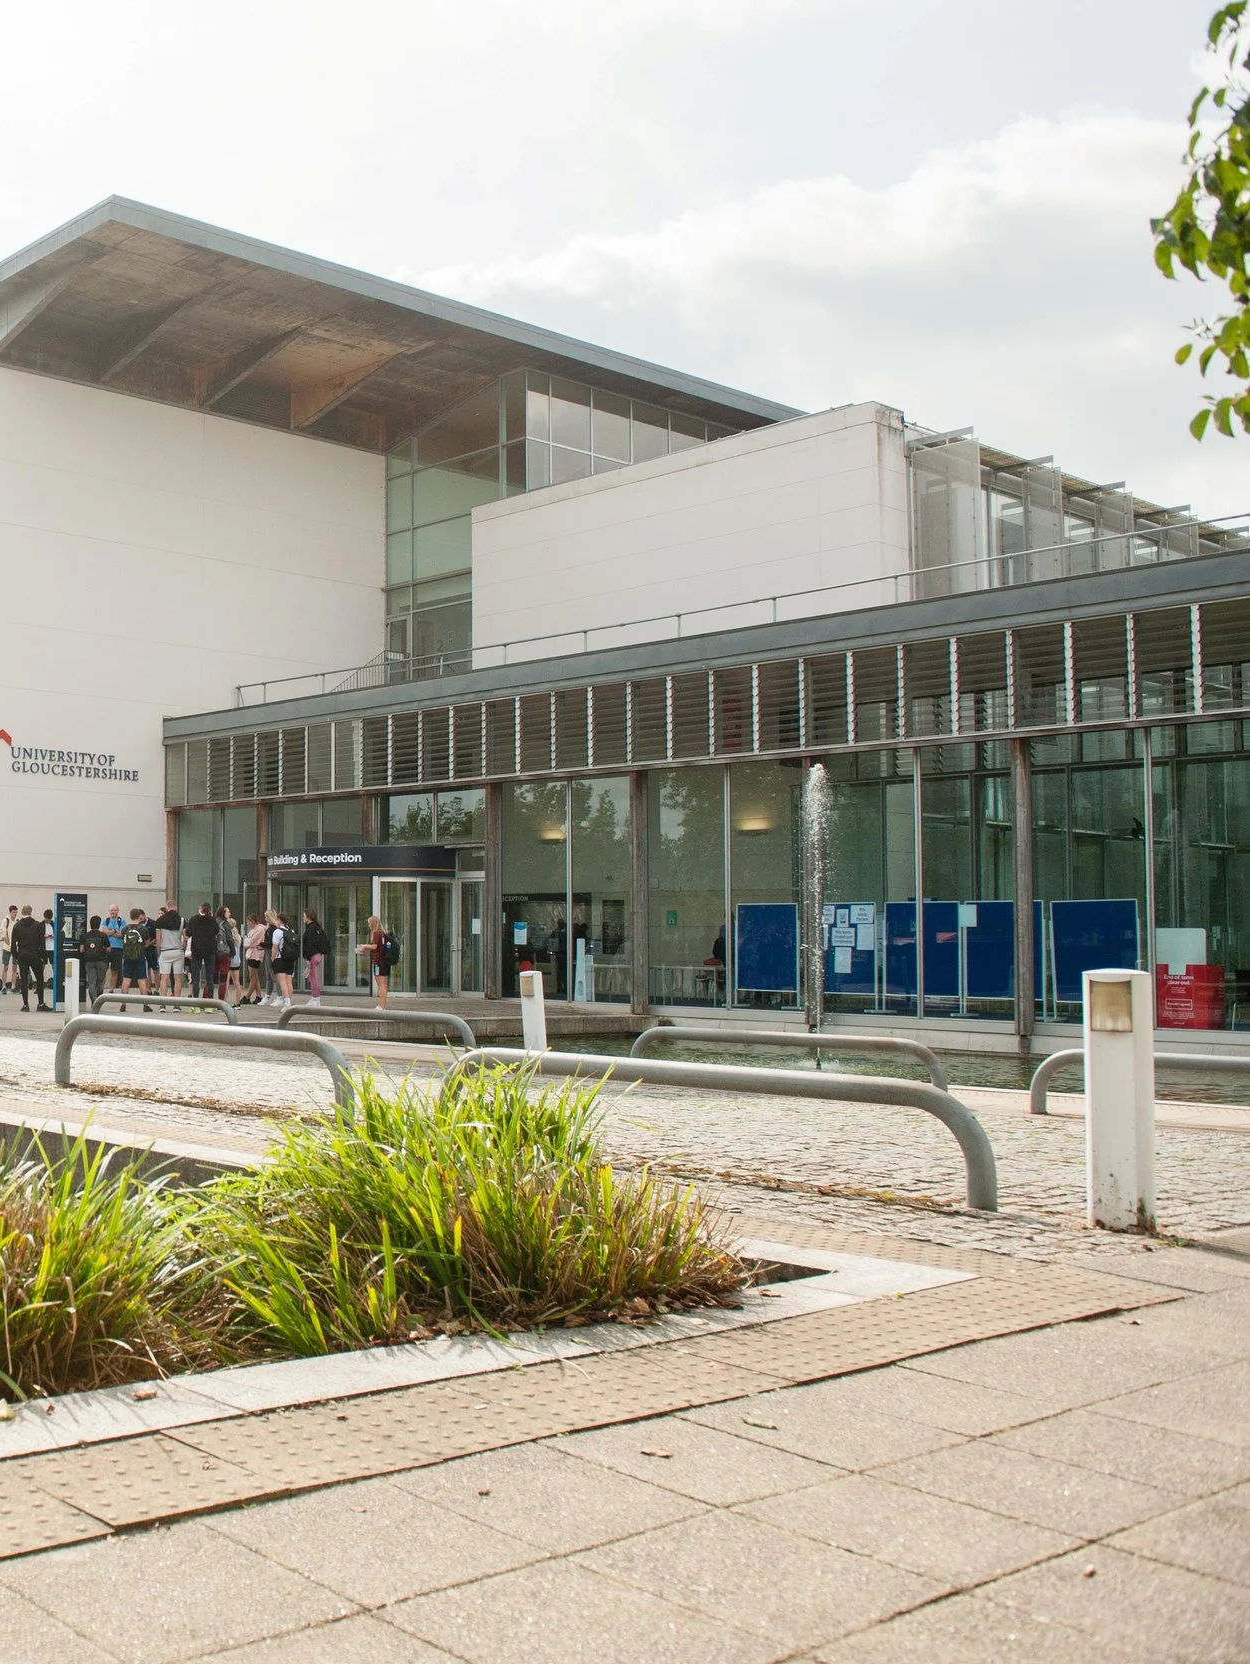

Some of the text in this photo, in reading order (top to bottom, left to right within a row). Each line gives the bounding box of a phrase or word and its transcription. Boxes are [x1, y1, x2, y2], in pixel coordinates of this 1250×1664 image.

[11, 746, 116, 767] UNIVERSITY OF
[12, 761, 139, 782] GLOUCESTERSHIRE
[274, 854, 298, 865] Building
[300, 854, 307, 863] &
[310, 852, 362, 864] Reception
